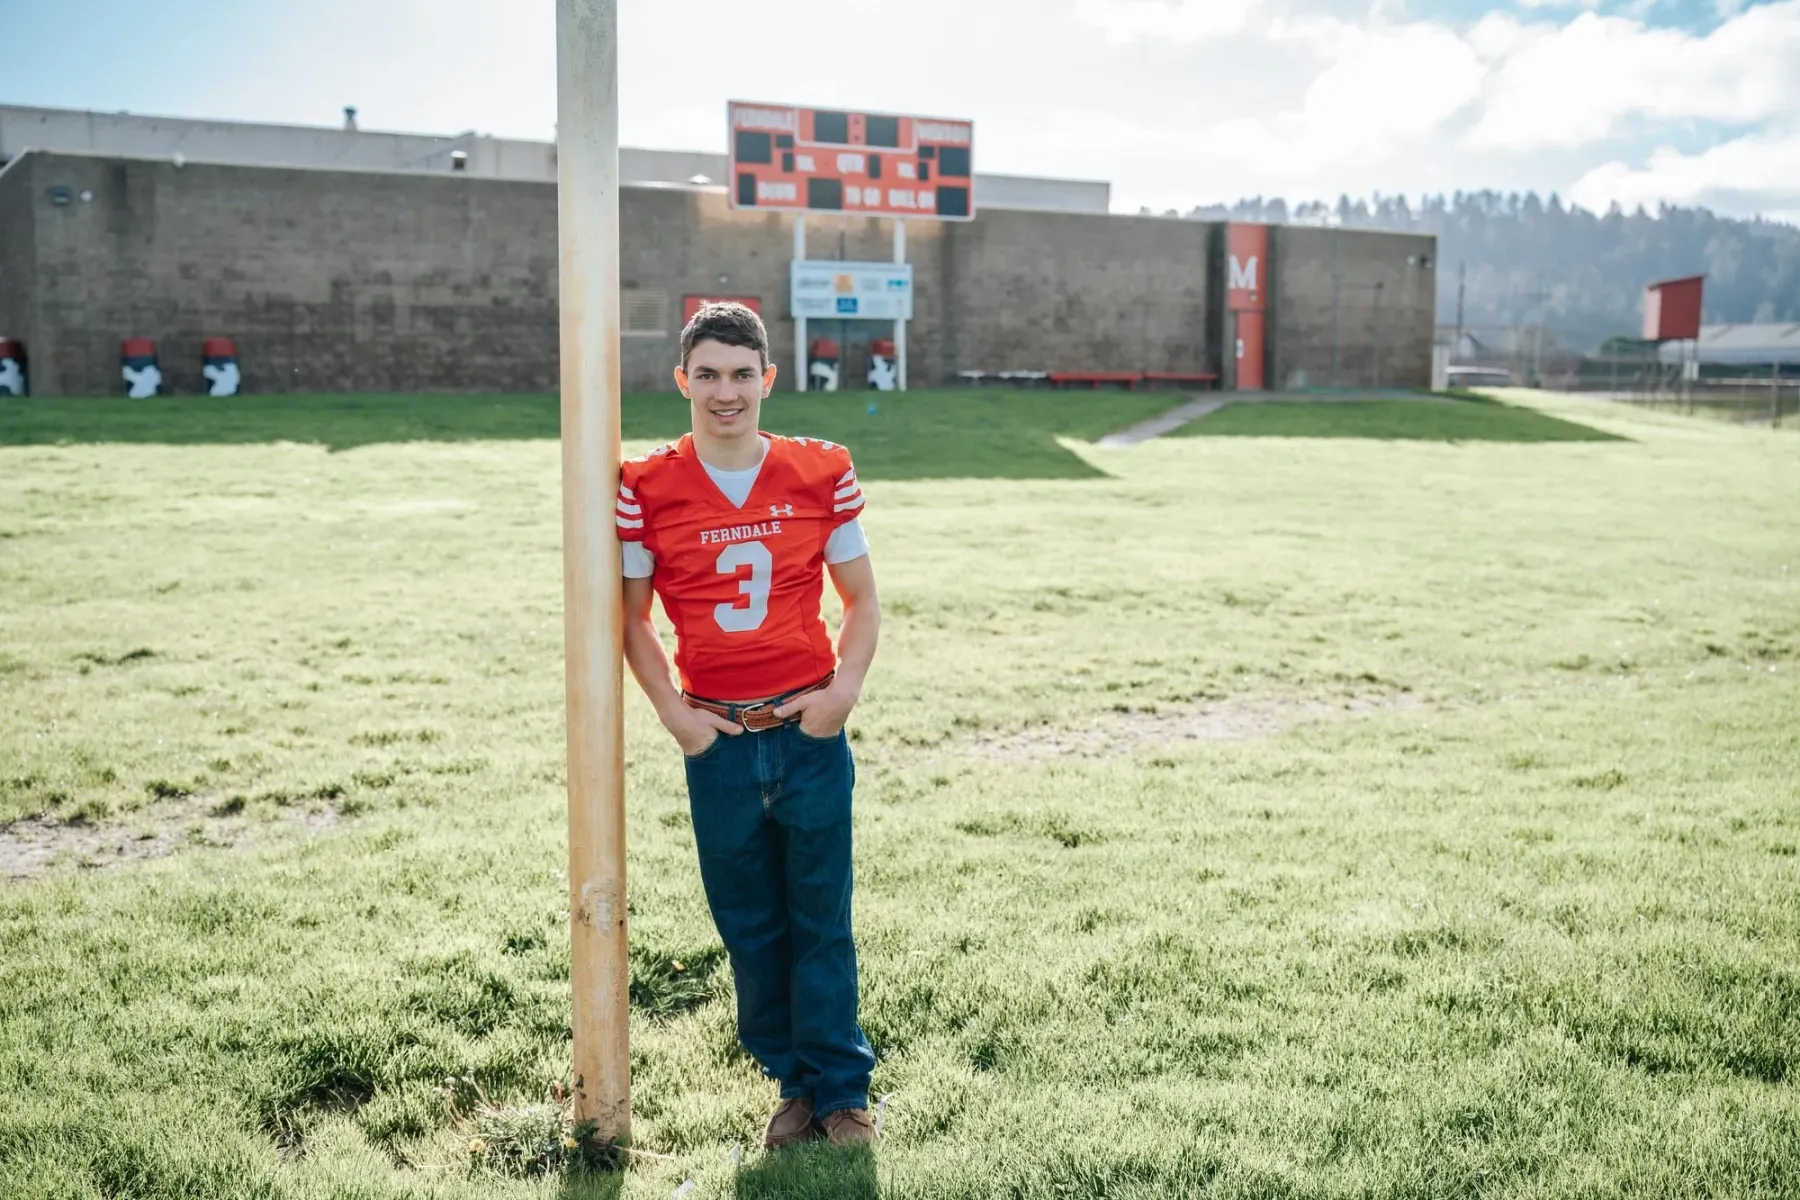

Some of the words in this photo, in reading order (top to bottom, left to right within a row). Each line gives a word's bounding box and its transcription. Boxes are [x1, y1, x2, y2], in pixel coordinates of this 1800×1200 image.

[1228, 254, 1258, 289] M
[700, 521, 782, 544] FERNDALE
[714, 541, 772, 632] 3
